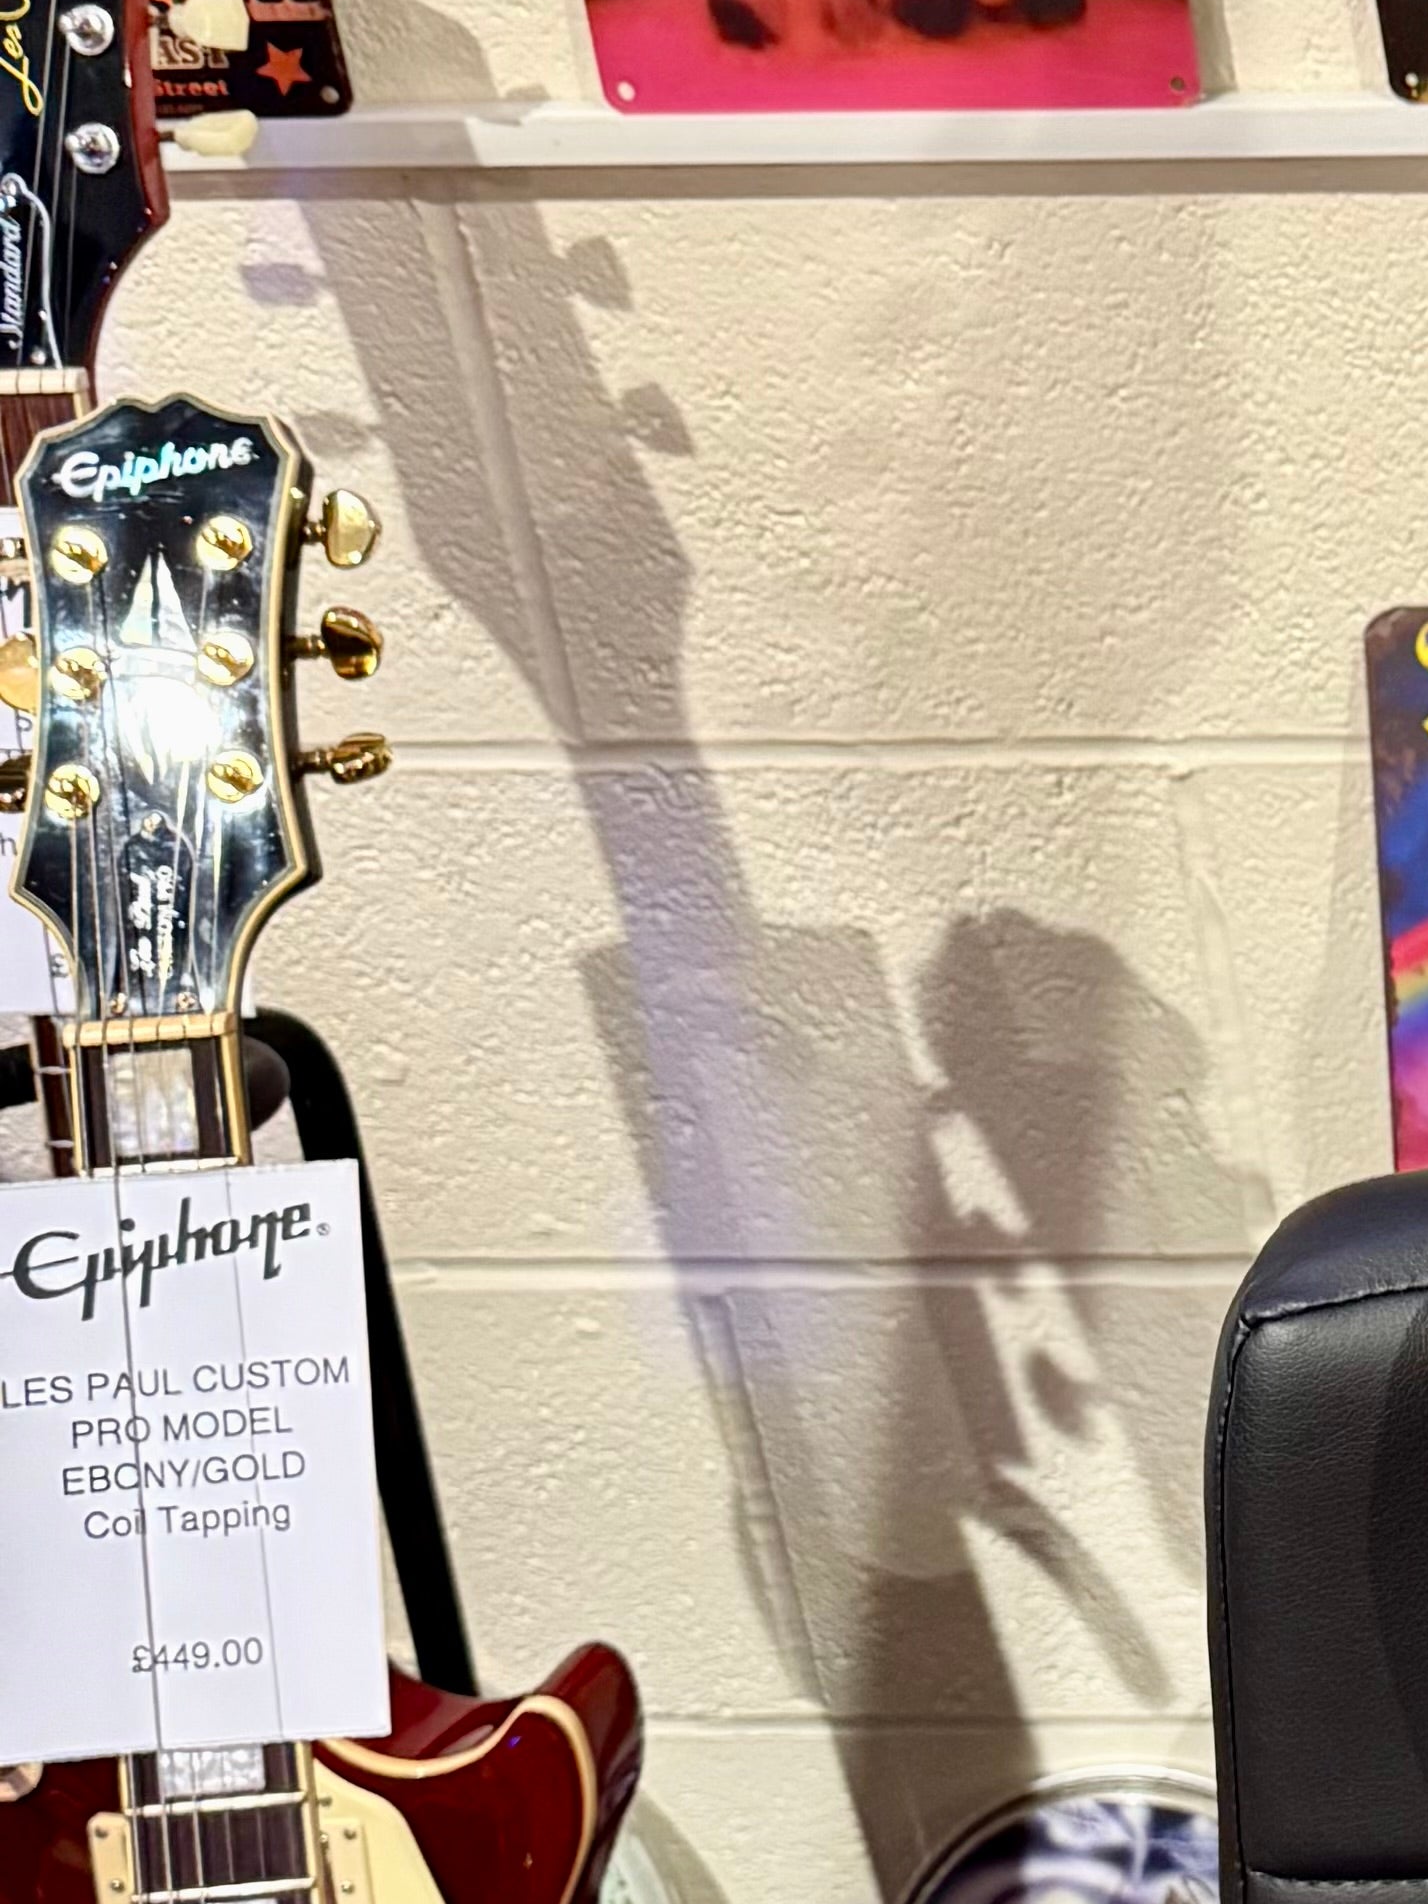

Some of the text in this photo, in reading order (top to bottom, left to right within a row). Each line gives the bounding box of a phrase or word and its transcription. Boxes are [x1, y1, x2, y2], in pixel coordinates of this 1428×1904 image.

[58, 434, 257, 502] Epiphone
[3, 1196, 313, 1322] Epiphone
[1, 1356, 350, 1411] LES PAUL CUSTOM
[71, 1406, 293, 1449] PRO MODEL
[61, 1450, 306, 1496] EBONY/GOLD
[83, 1499, 292, 1541] Coil Tapping
[131, 1637, 265, 1674] £449.00
